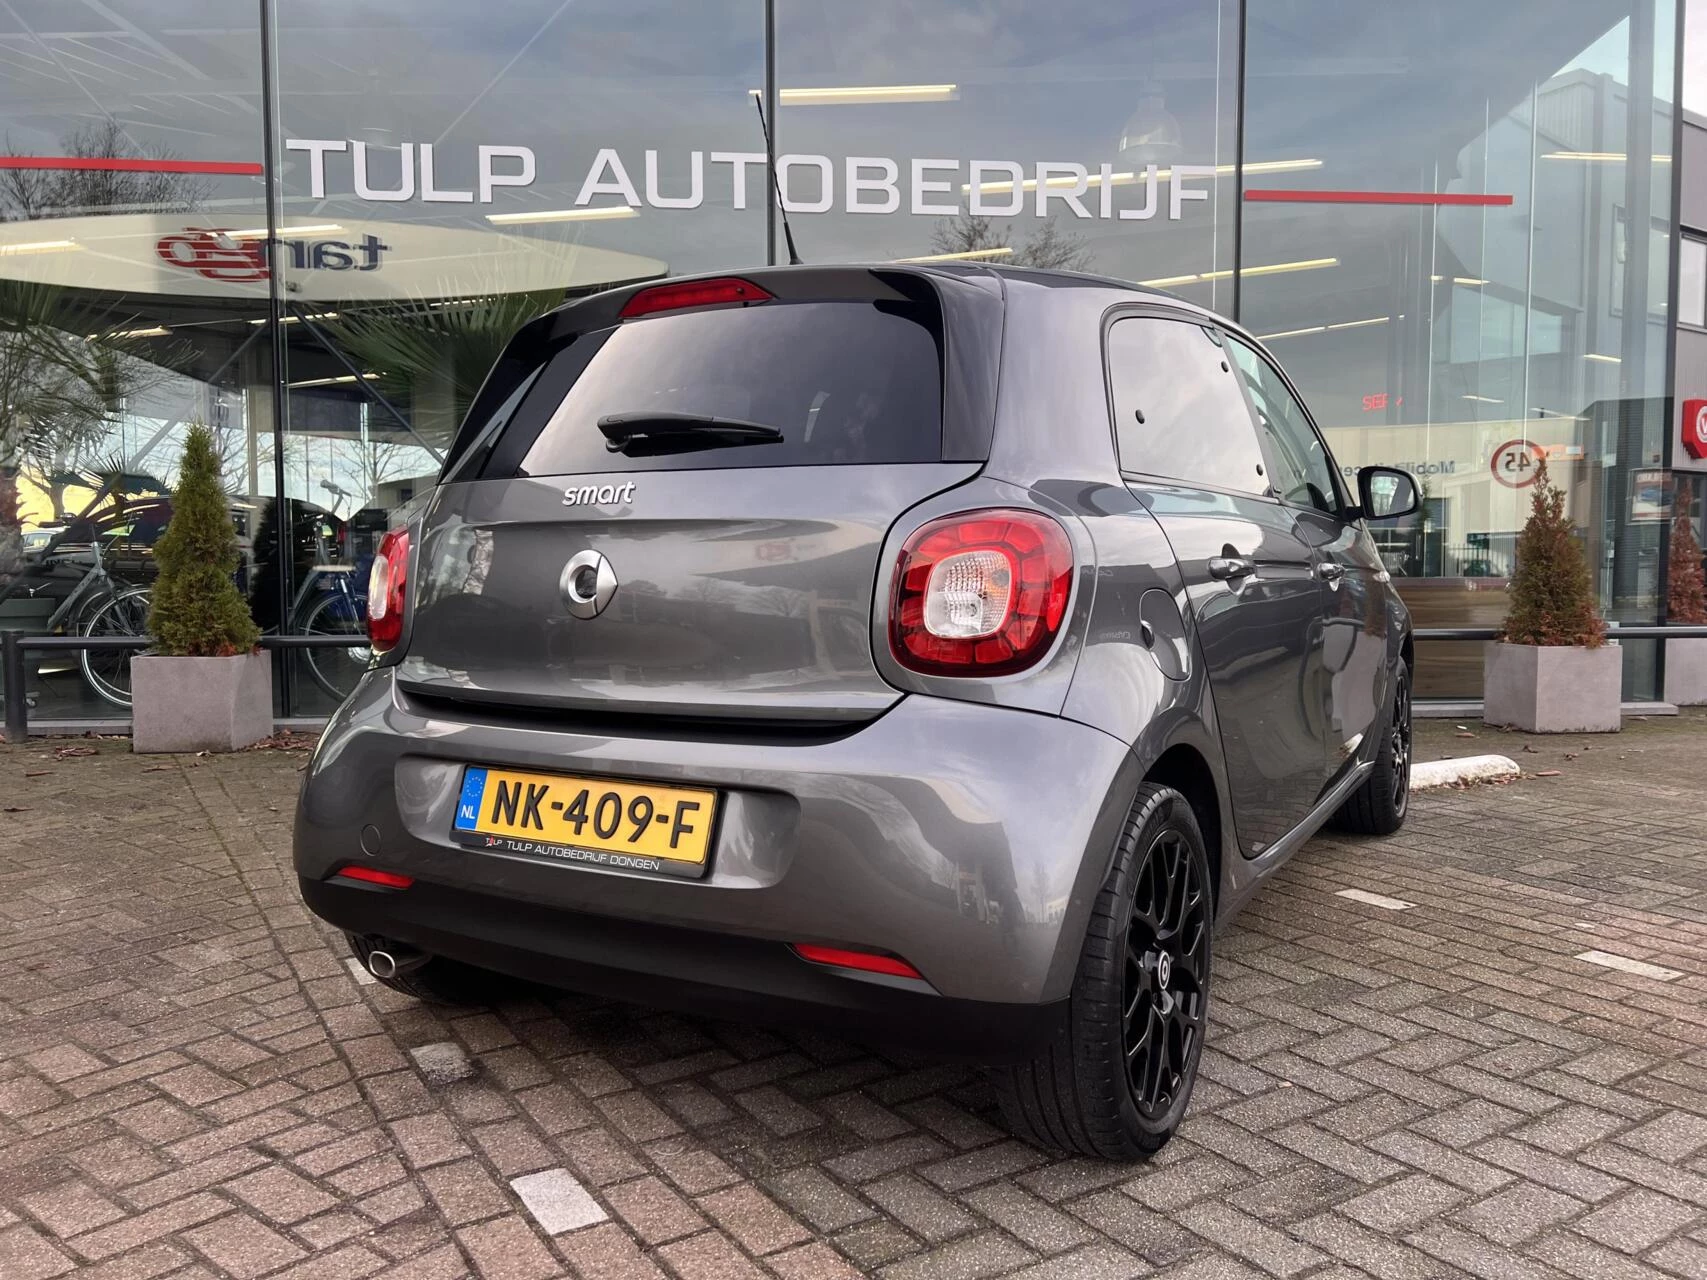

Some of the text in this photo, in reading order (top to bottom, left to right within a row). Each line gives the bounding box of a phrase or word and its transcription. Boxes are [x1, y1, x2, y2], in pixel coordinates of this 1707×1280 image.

[285, 138, 1218, 221] TULP AUTOBEDRIJF
[561, 481, 637, 506] smart
[460, 780, 700, 849] NL NK-409-F
[506, 840, 533, 852] TULP
[534, 844, 608, 862] AUTOBEDRIJF
[609, 855, 660, 871] DONGEN
